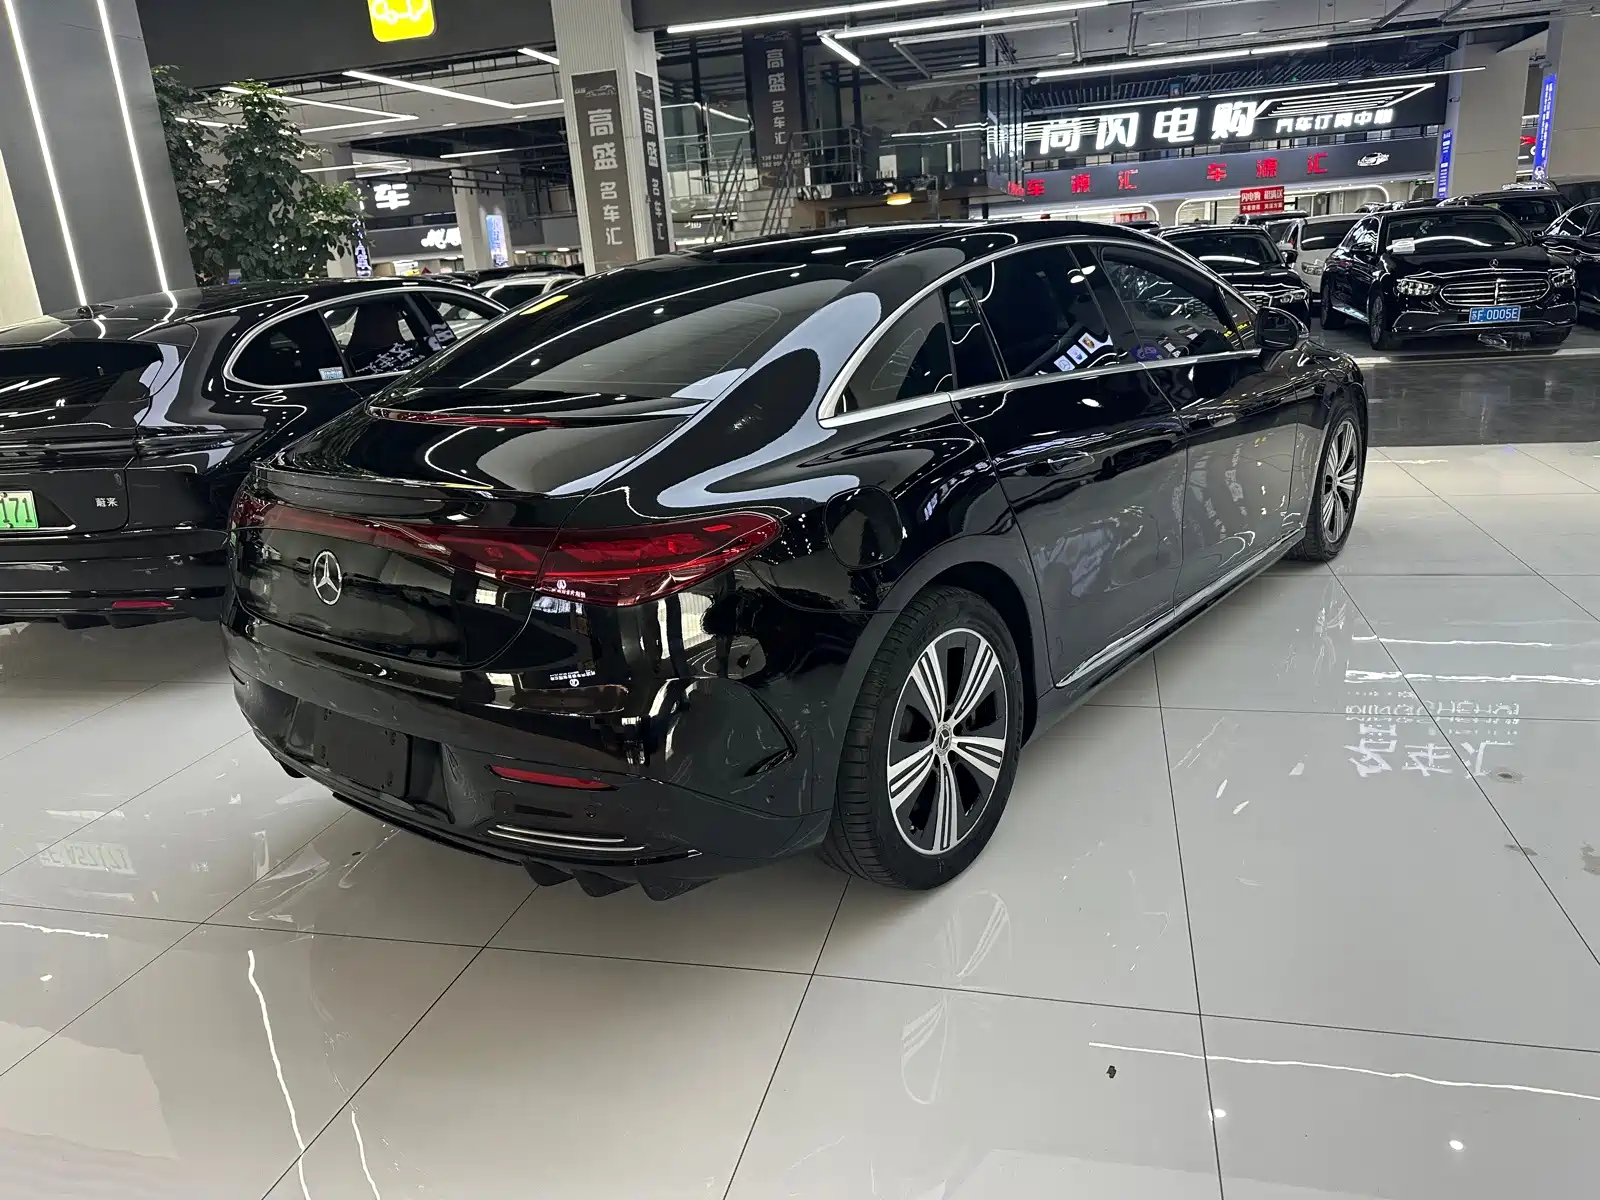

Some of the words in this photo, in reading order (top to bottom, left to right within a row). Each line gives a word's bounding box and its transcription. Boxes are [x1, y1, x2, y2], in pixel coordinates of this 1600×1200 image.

[765, 48, 787, 145] 高盛名车汇
[587, 107, 624, 246] 高盛名车汇
[642, 107, 665, 241] 高盛名车汇
